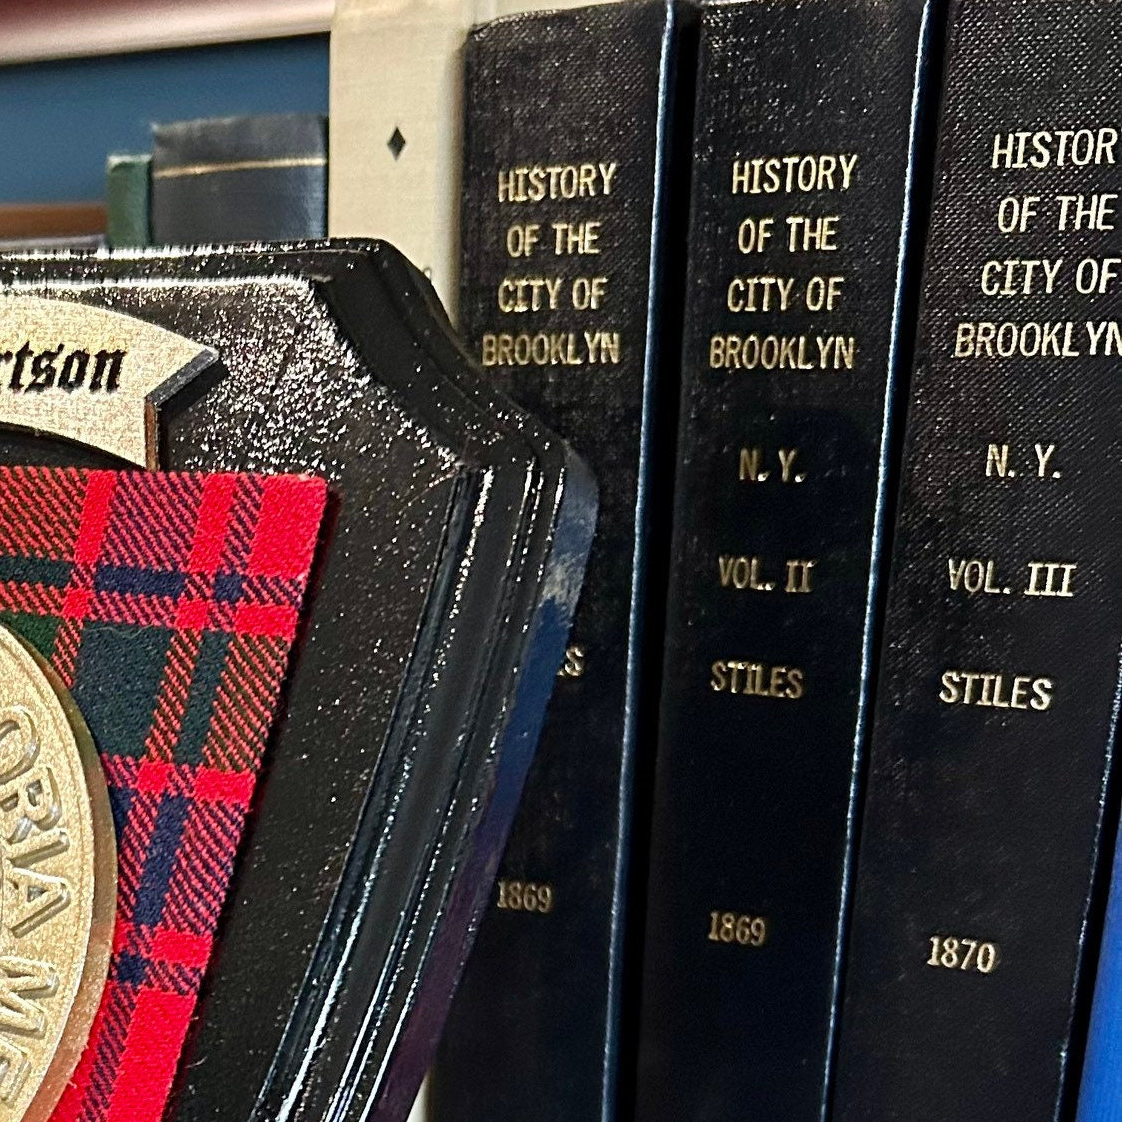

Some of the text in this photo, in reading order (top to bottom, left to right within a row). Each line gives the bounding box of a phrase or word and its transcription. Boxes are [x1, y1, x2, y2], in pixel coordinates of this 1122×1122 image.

[498, 162, 616, 202] HISTORY
[732, 154, 858, 194] HISTORY
[997, 193, 1119, 233] OF THE
[506, 221, 603, 258] OF THE
[738, 215, 840, 254] OF THE
[497, 277, 609, 312] CITY OF
[728, 276, 845, 312] CITY OF
[981, 258, 1122, 296] CITY OF
[481, 331, 622, 366] BROOKLYN
[709, 334, 855, 369] BROOKLYN
[952, 320, 1122, 358] BROOKLYN
[739, 447, 806, 483] N. Y.
[985, 443, 1062, 479] N. Y.
[718, 556, 818, 593] VOL. II
[948, 558, 1077, 597] VOL. III
[710, 660, 804, 698] STILES
[939, 670, 1054, 711] STILES
[496, 880, 554, 913] 1869
[708, 910, 767, 946] 1869
[927, 936, 997, 974] 1870
